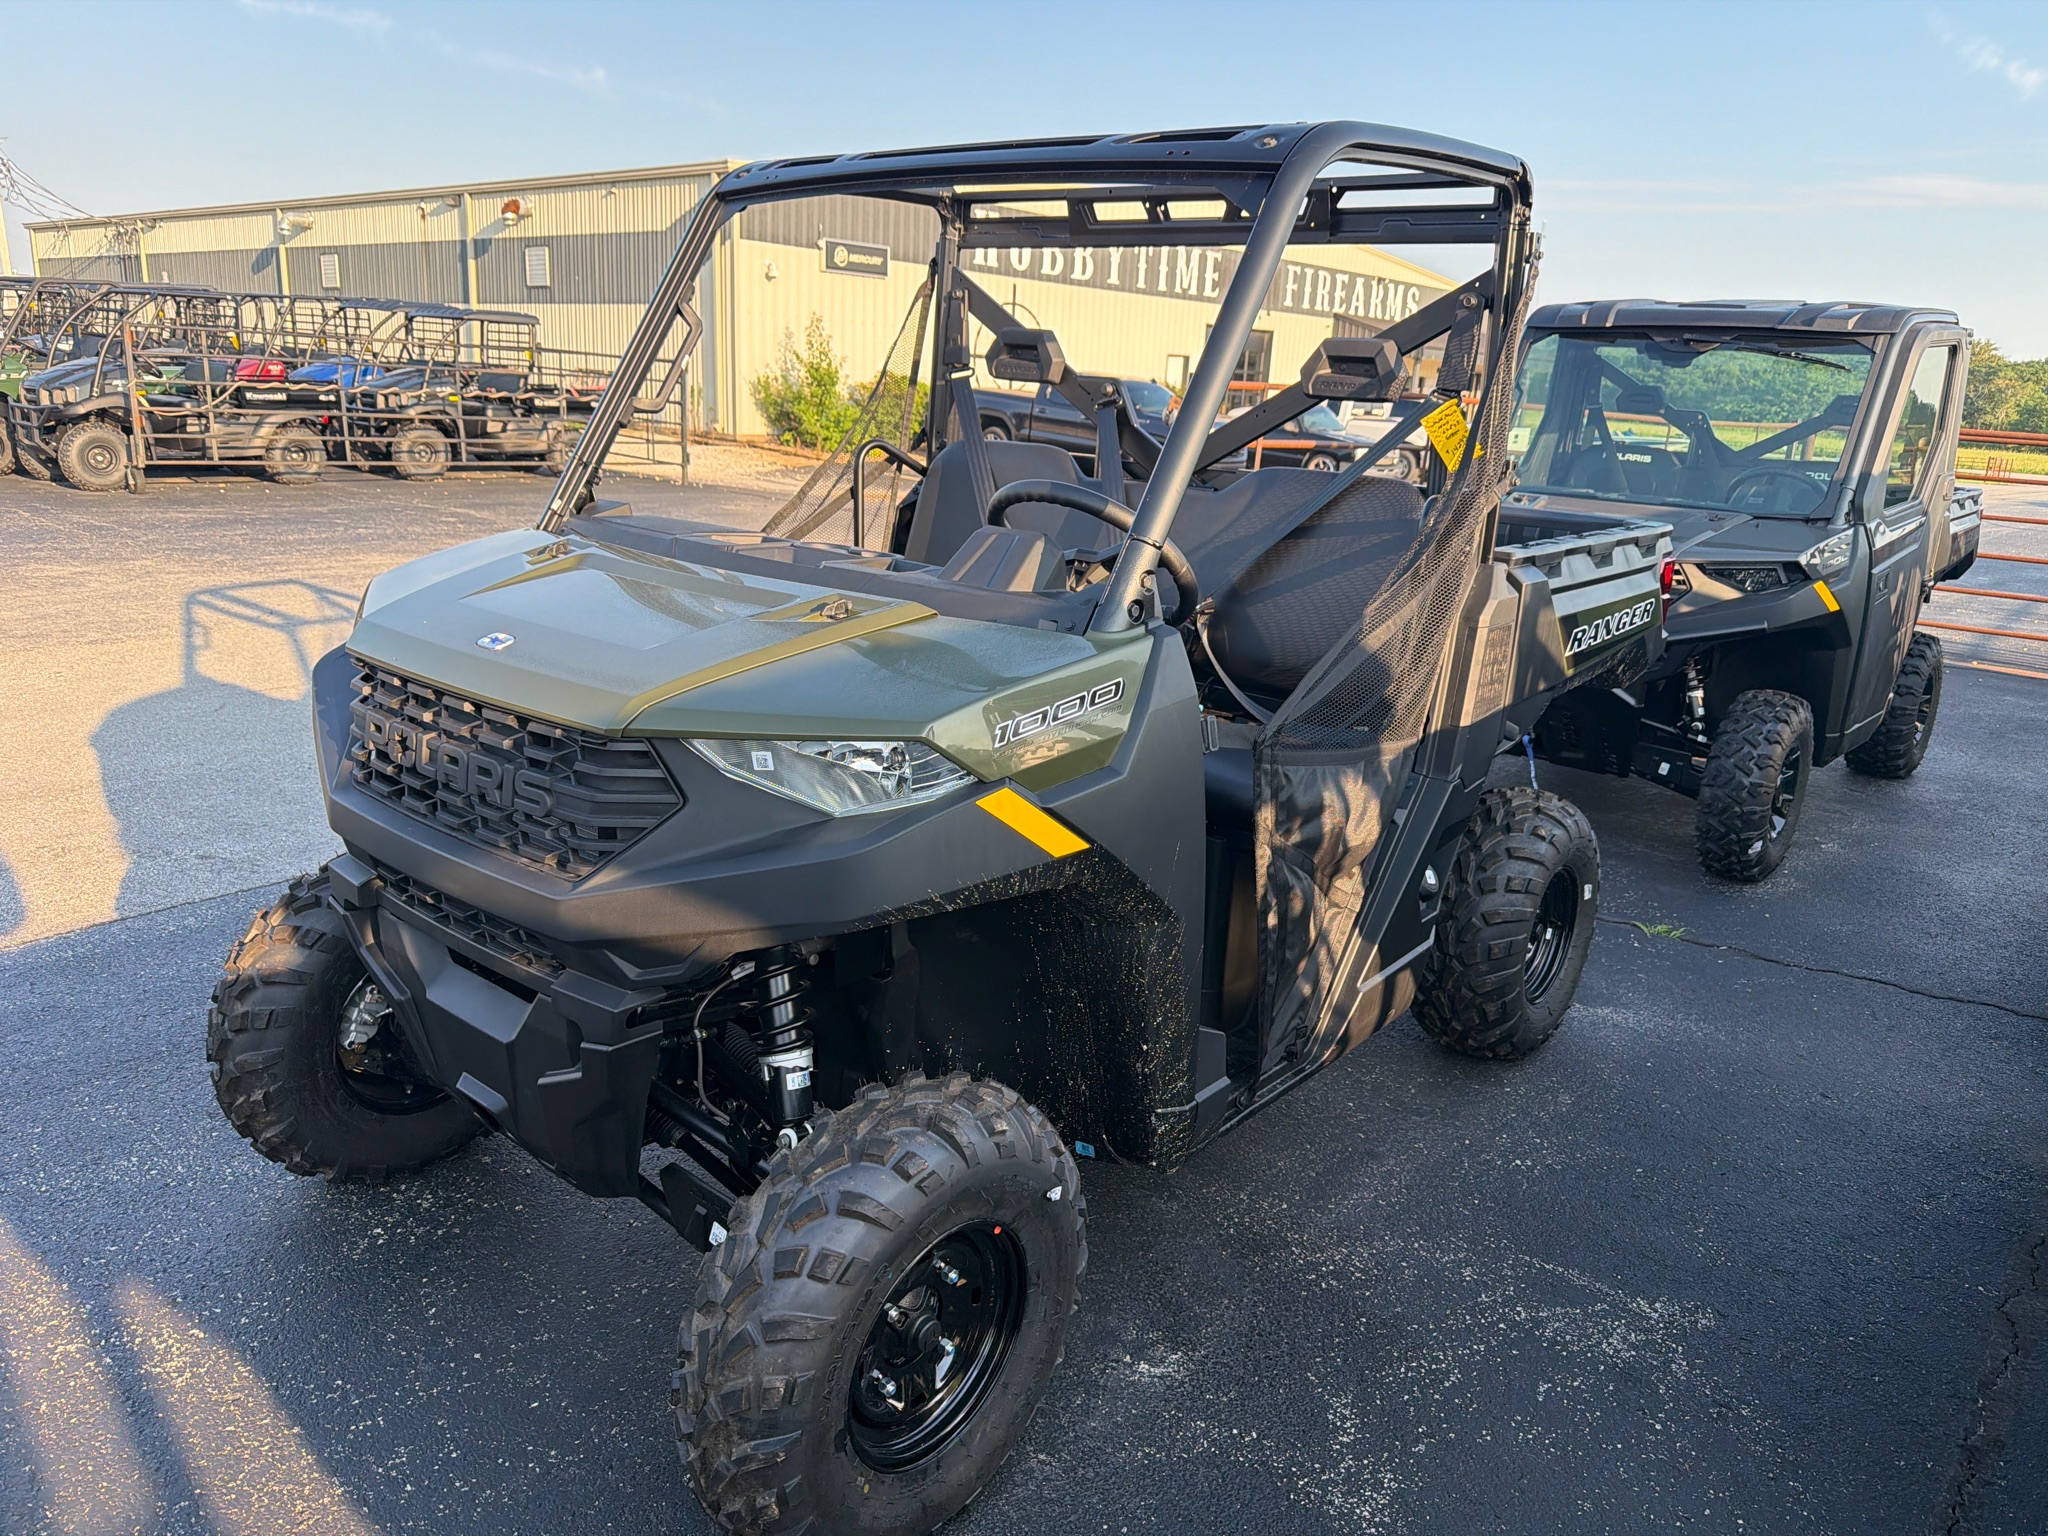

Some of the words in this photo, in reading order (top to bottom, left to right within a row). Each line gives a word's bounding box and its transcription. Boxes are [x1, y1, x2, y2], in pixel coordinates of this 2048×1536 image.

[1283, 264, 1420, 321] FIREARMS
[245, 391, 288, 401] Kawasaki
[1615, 452, 1652, 464] LARIS
[1564, 598, 1656, 657] RANGER
[994, 677, 1125, 749] 1000
[365, 707, 556, 818] POLARIS
